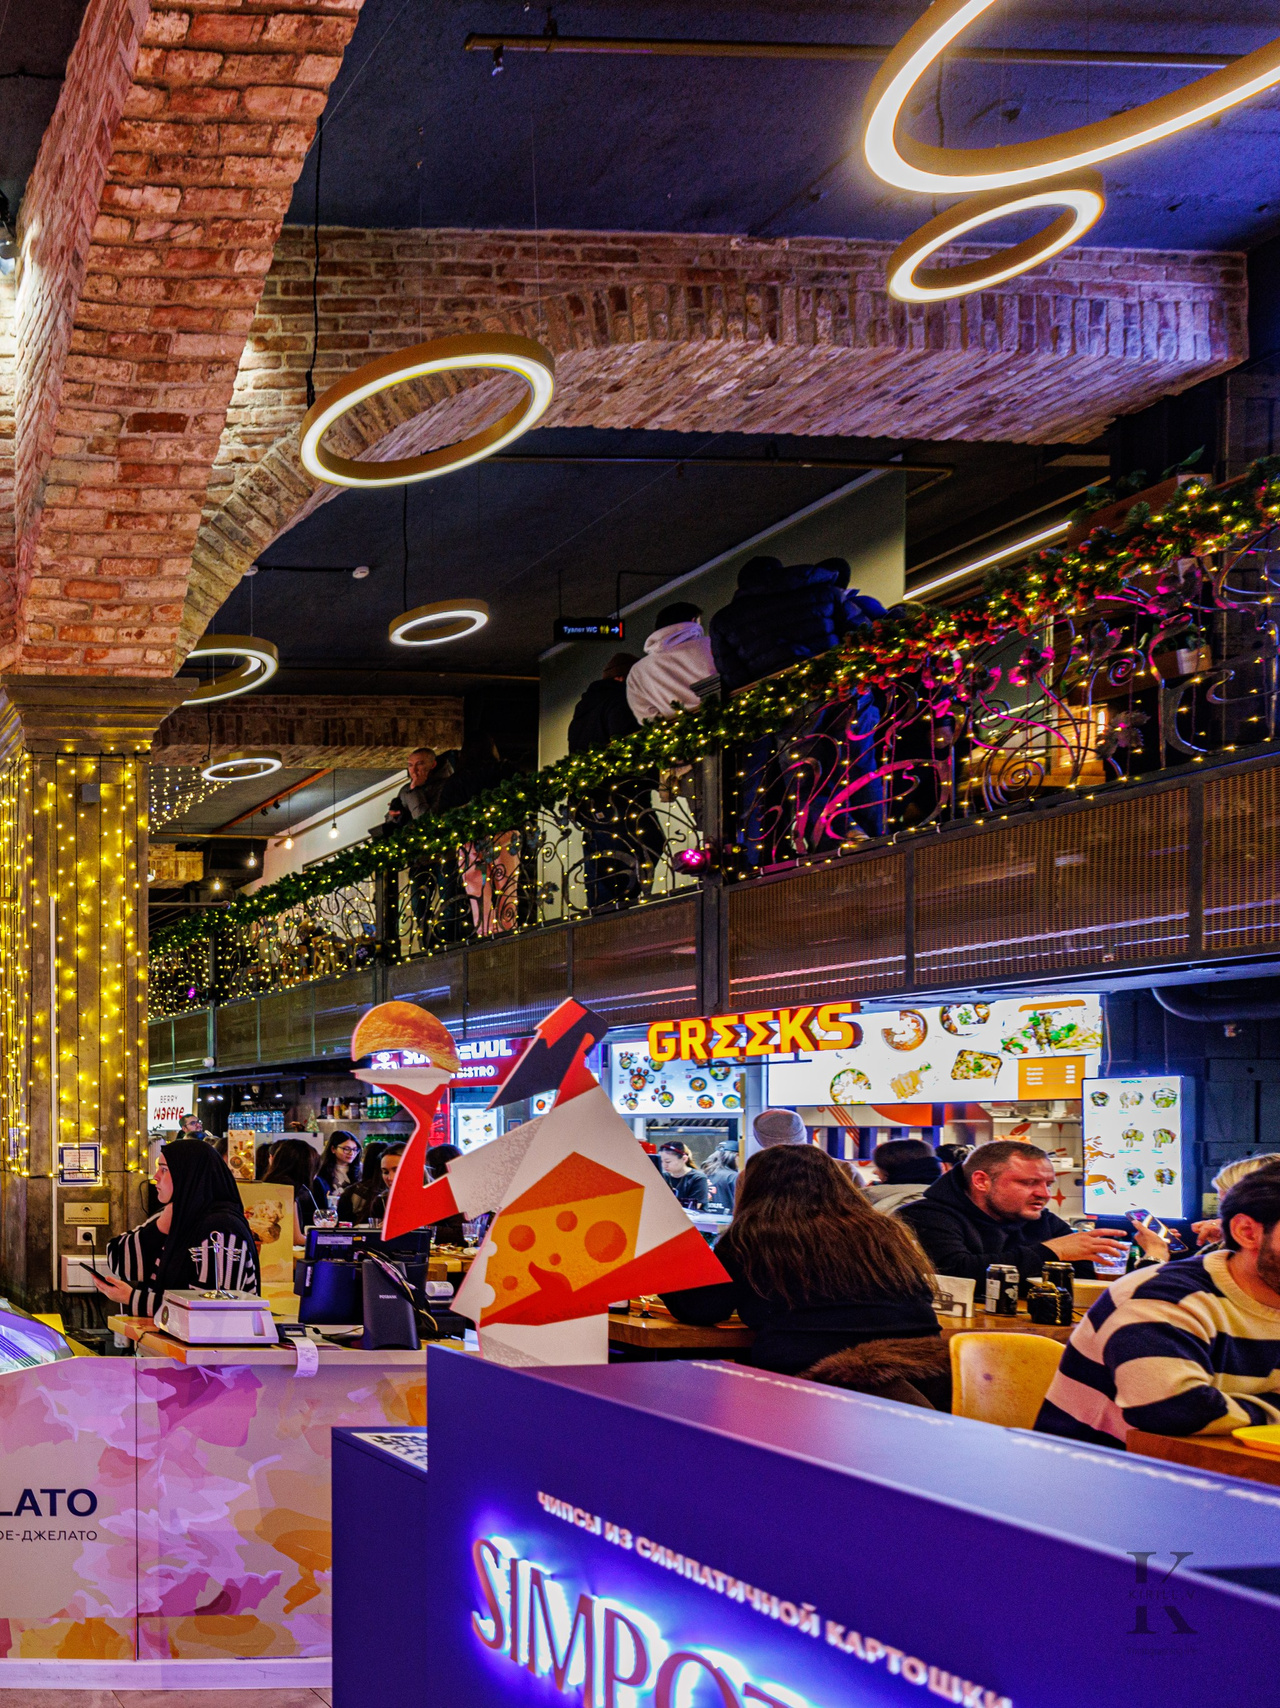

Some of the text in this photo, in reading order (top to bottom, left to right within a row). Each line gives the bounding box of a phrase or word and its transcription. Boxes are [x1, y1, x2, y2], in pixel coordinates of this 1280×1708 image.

[537, 1490, 602, 1536] ЧИПСЫ
[604, 1521, 633, 1549] ИЗ
[635, 1535, 822, 1638] СИМПАТИЧНОЙ
